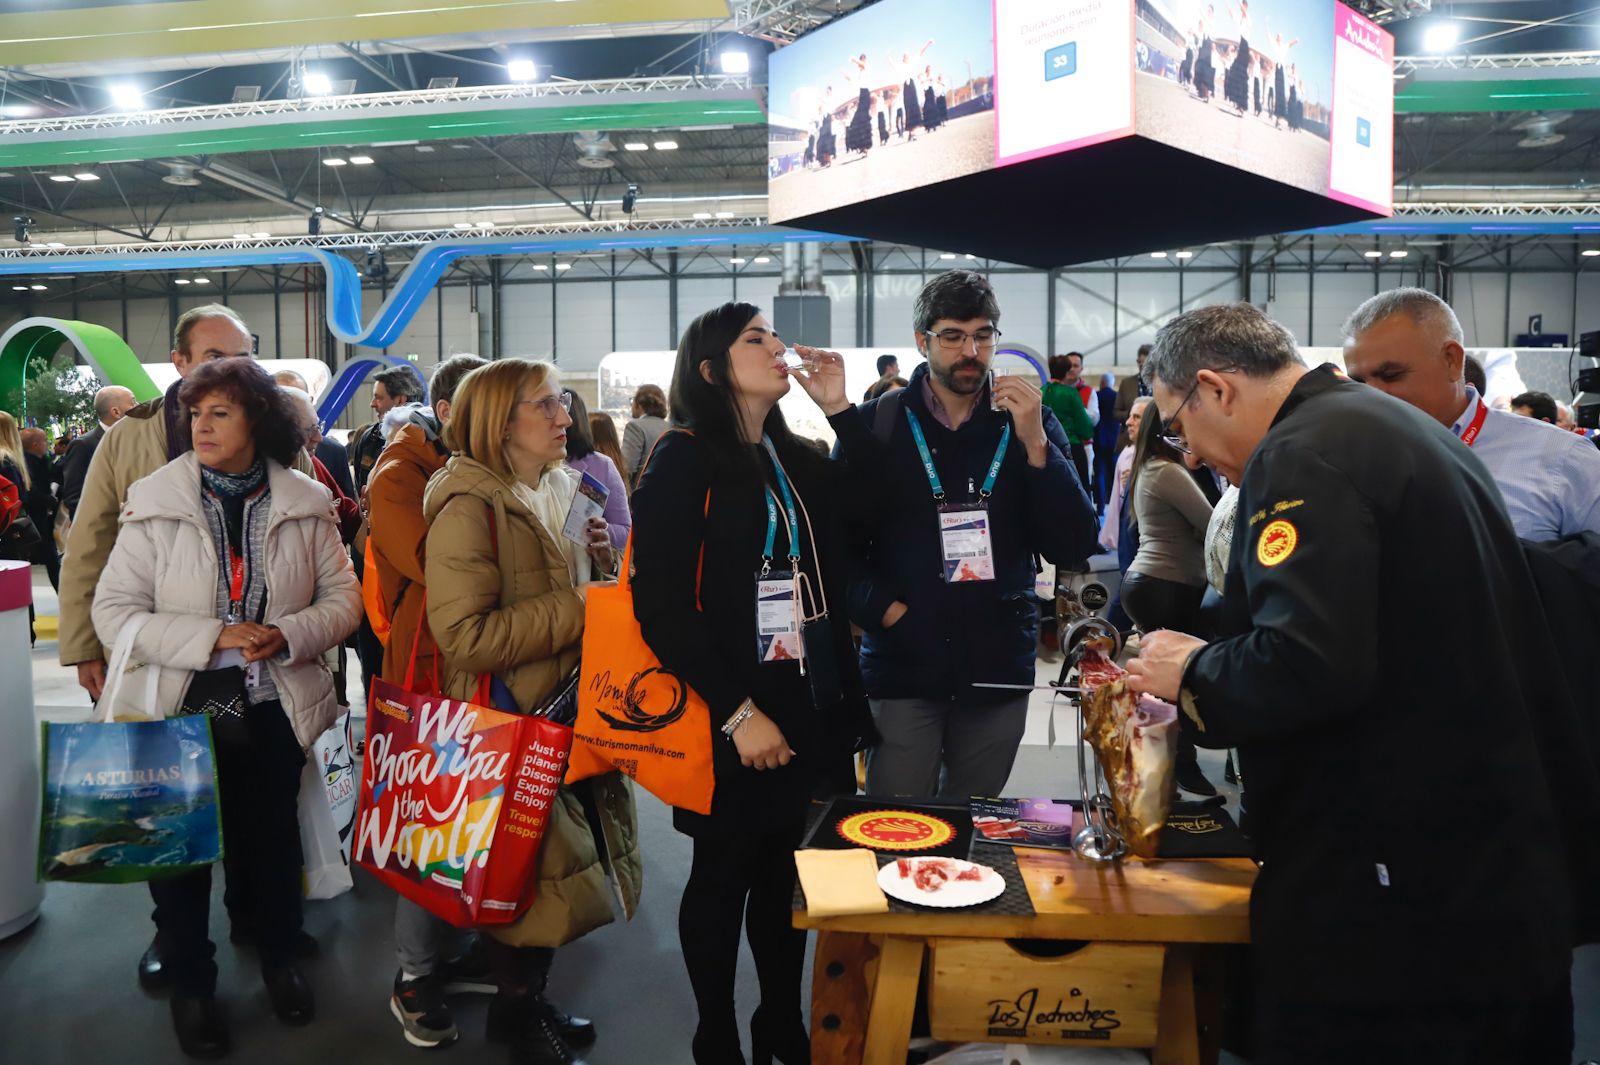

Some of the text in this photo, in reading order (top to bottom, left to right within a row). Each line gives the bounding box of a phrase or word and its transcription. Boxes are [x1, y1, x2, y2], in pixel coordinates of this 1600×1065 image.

[1053, 54, 1068, 68] 33
[1530, 317, 1539, 336] C
[418, 699, 478, 747] We
[528, 741, 555, 757] Just
[575, 732, 685, 760] www.turismomanilva.com
[367, 732, 447, 792] Show
[80, 765, 181, 786] ASTURIAS
[520, 766, 561, 784] Discov
[326, 778, 353, 804] ICAR
[513, 791, 548, 810] Enjoy.
[400, 788, 425, 820] the
[356, 794, 500, 874] World!
